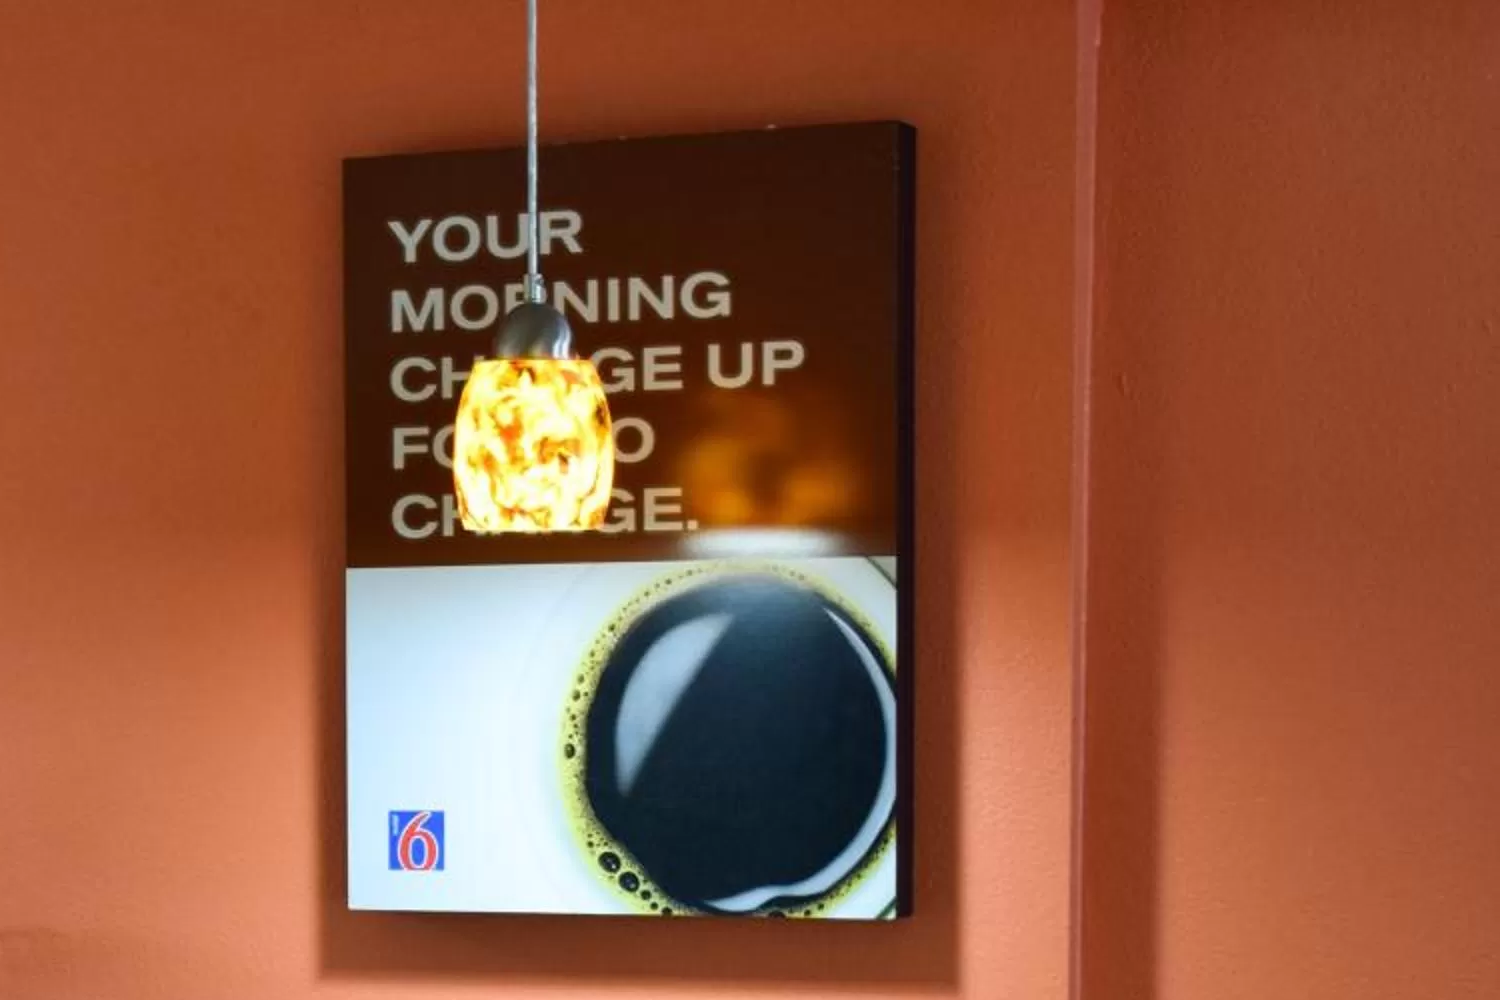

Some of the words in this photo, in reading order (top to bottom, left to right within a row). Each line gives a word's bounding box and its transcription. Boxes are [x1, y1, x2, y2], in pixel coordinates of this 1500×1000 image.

[387, 209, 584, 263] YOUR
[391, 271, 731, 333] MONING
[389, 345, 683, 401] CHGE
[708, 340, 805, 388] UP
[391, 487, 698, 539] CGE.
[398, 809, 438, 872] 6
